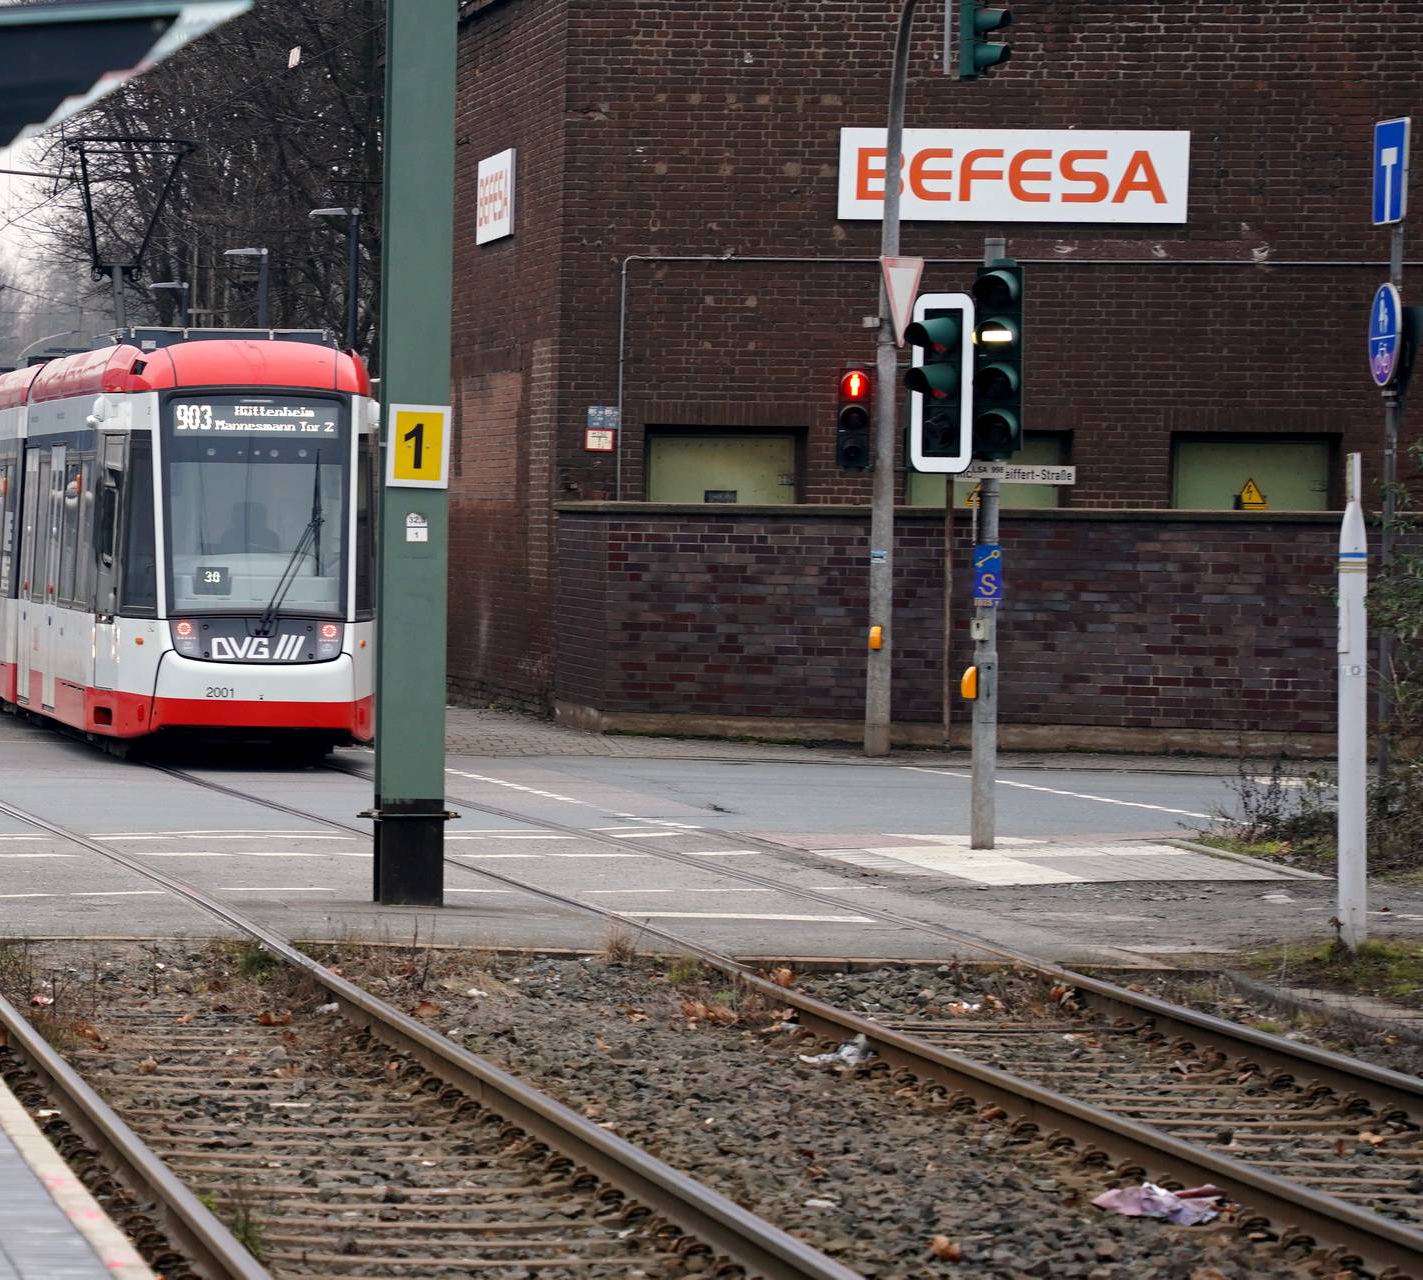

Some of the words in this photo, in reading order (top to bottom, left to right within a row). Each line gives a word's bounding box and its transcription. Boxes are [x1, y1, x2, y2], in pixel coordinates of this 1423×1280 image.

[856, 148, 1169, 204] BEFESA
[176, 405, 213, 430] 903
[234, 405, 315, 417] Hüttenheim
[214, 420, 296, 432] Mannesmann
[299, 421, 321, 432] Tor
[323, 421, 335, 432] 2
[404, 423, 424, 469] 1
[981, 573, 996, 596] S
[211, 637, 270, 660] DVG
[206, 686, 235, 699] 2001
